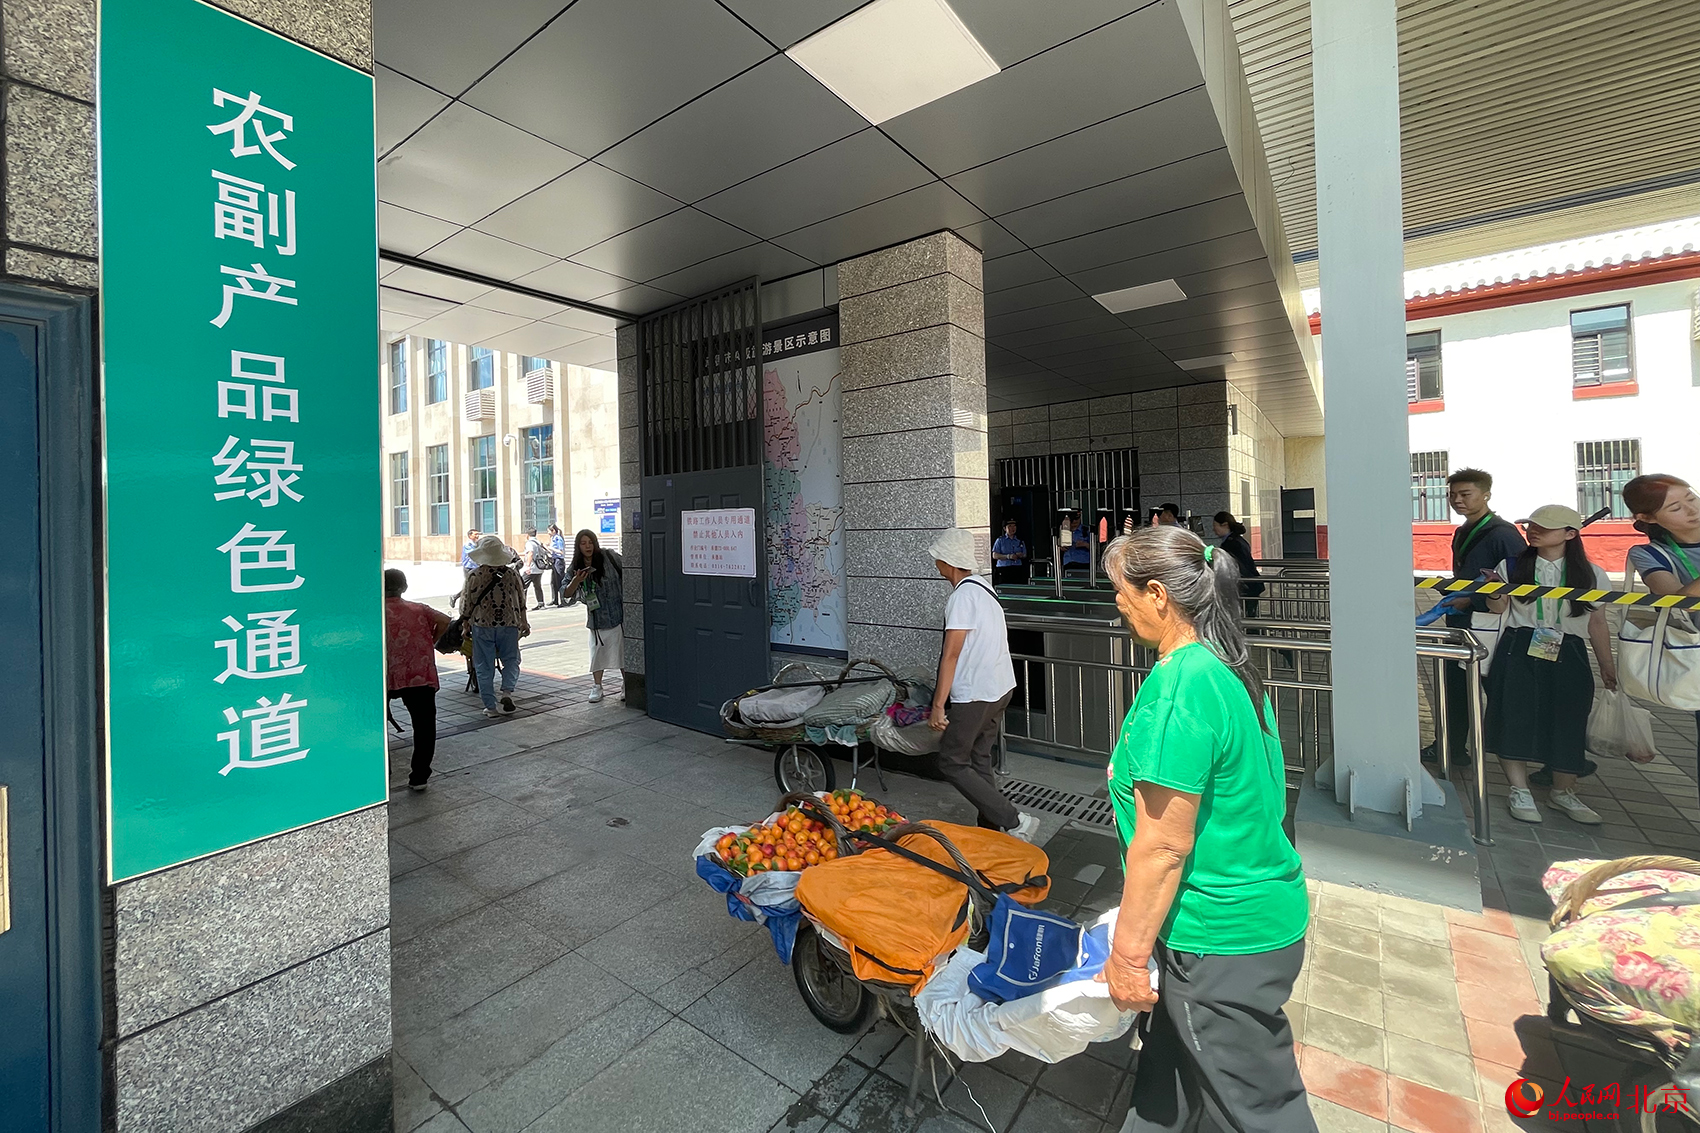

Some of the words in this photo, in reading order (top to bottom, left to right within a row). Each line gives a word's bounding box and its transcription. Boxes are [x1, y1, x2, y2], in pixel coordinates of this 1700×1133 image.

[205, 86, 311, 777] 农副产品绿色通道
[686, 515, 751, 525] 铁路工作人员专用通道
[693, 529, 744, 539] 禁止其他人员入内
